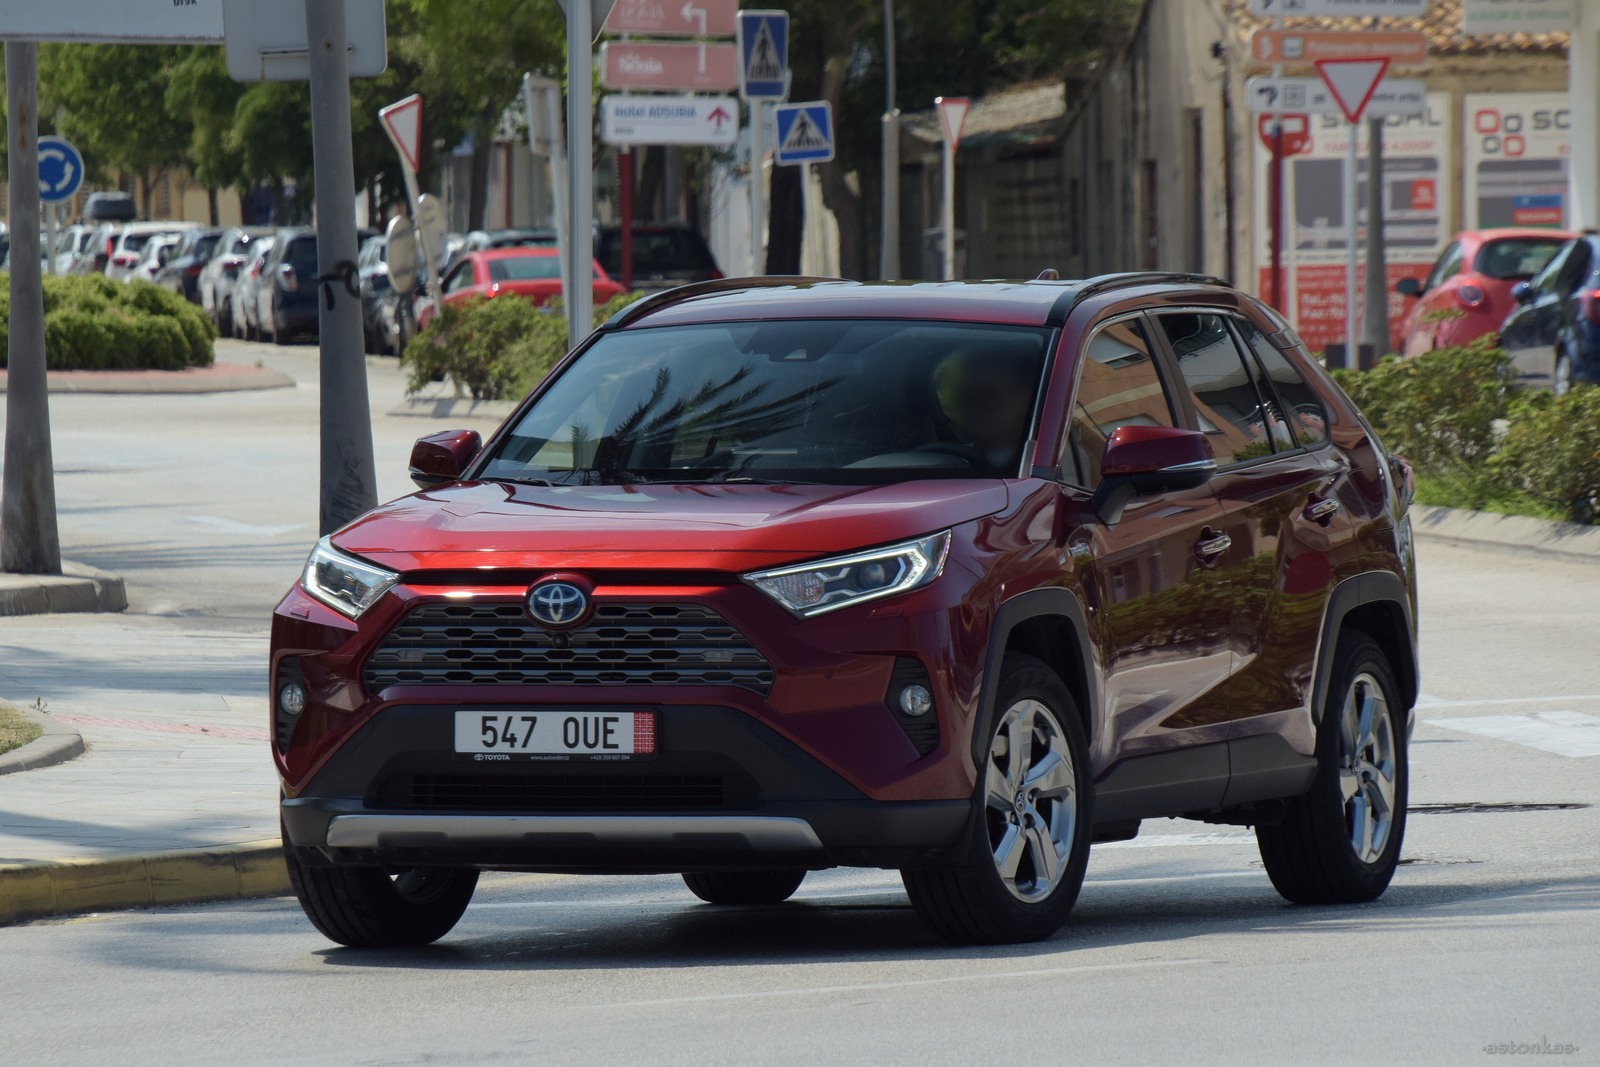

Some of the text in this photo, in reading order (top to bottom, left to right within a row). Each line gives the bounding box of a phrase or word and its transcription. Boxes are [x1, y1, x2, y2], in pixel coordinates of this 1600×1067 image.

[615, 105, 646, 118] Hotel
[481, 716, 537, 748] 547
[484, 753, 511, 761] TOYOTA
